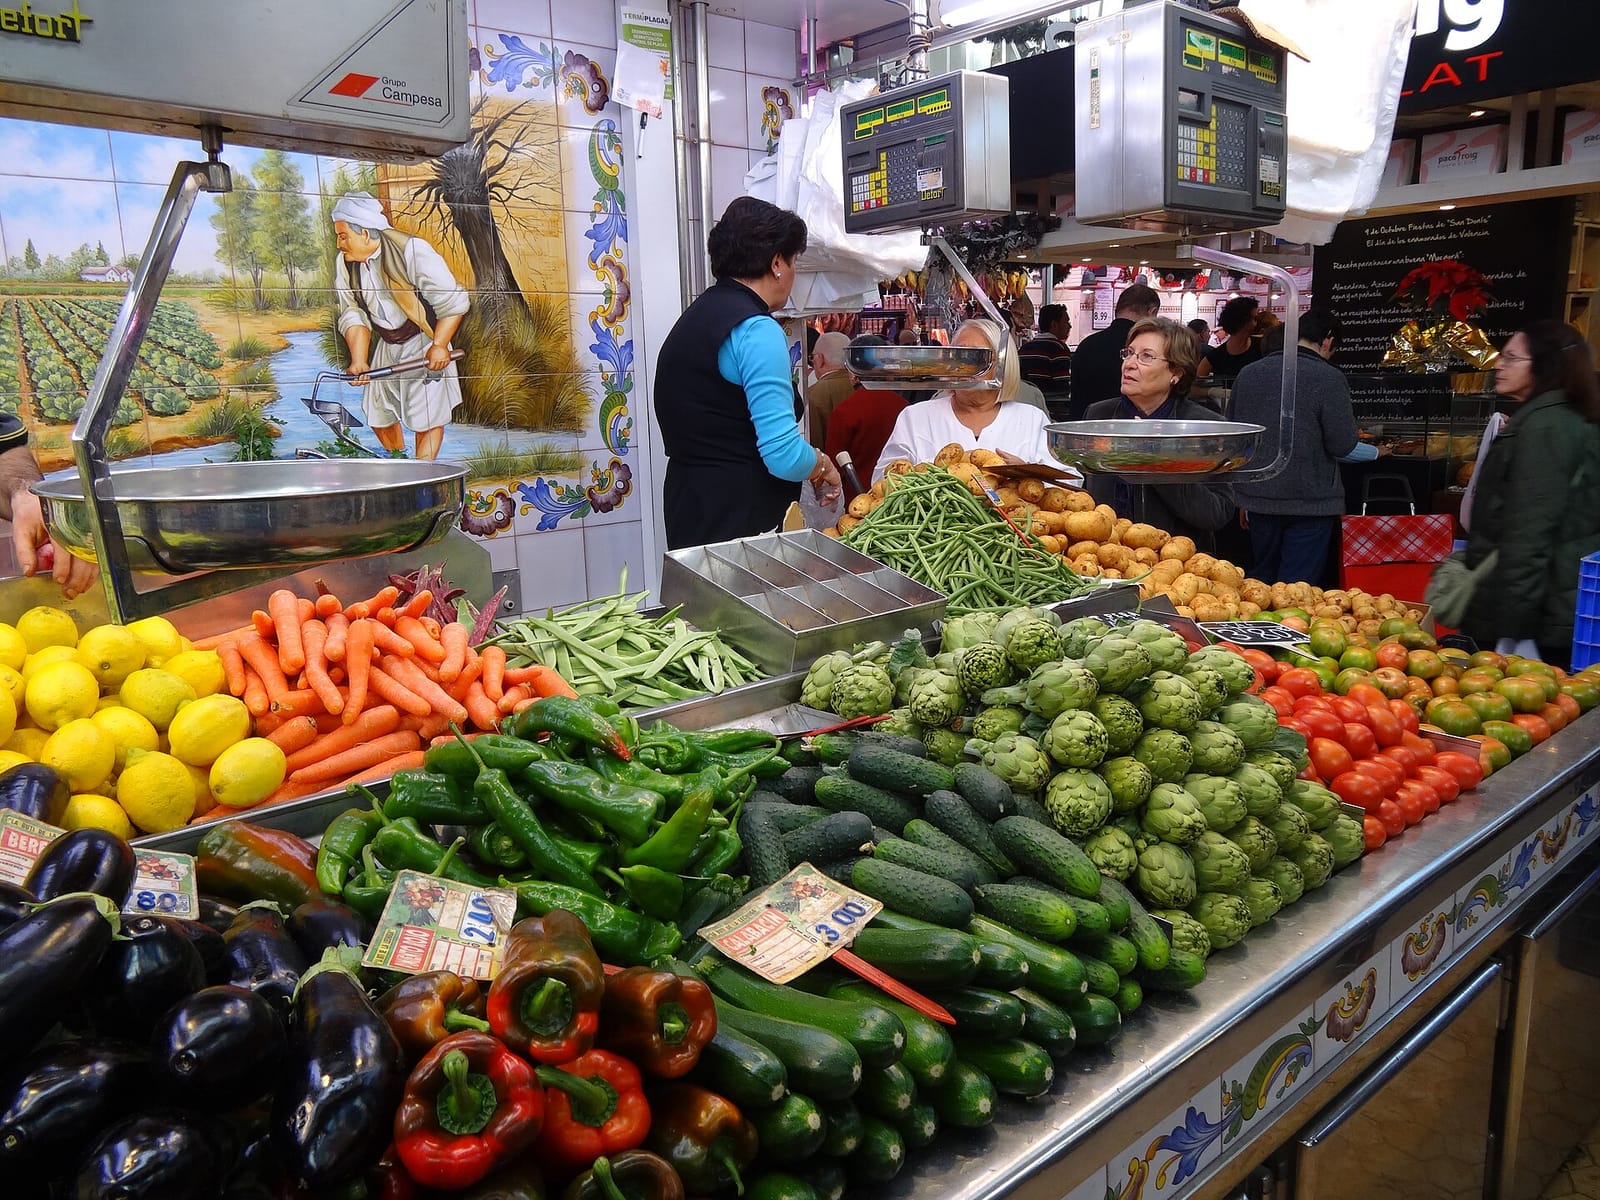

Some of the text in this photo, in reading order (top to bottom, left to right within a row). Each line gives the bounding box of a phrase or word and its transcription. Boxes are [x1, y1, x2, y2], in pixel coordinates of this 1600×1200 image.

[1401, 51, 1504, 96] AT
[381, 76, 407, 87] Grupo
[382, 86, 442, 107] Campesa
[1438, 153, 1457, 163] paco
[1380, 224, 1407, 234] Octubre
[1408, 221, 1435, 231] Fiestas
[1435, 220, 1446, 228] de
[1366, 239, 1374, 247] El
[1396, 236, 1407, 244] los
[1407, 233, 1447, 243] enamorados
[1459, 228, 1490, 238] Valencia
[1332, 260, 1358, 270] Receta
[1404, 254, 1426, 263] buena
[1516, 269, 1528, 278] de
[1348, 307, 1381, 318] recipiente
[722, 910, 785, 951] CALABACIN
